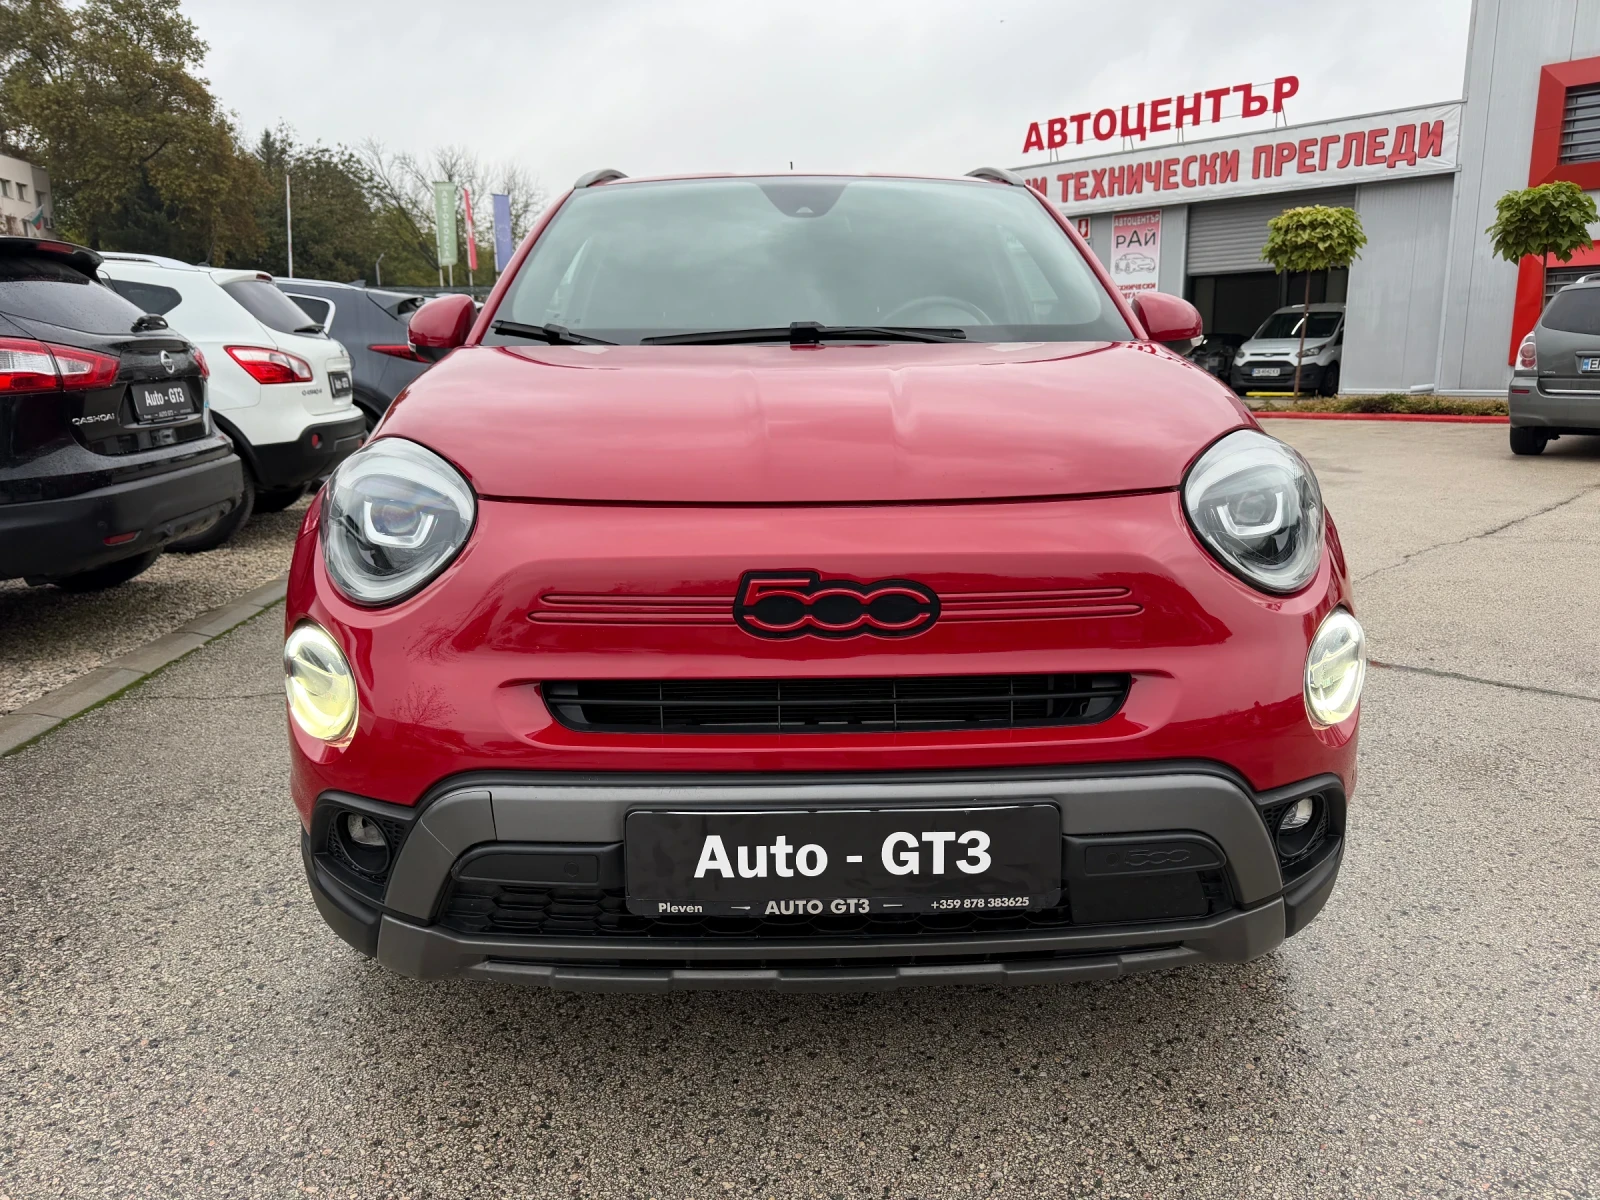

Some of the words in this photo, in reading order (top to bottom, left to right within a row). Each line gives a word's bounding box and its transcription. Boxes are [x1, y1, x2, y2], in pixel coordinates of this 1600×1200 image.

[1023, 75, 1300, 154] АВТОЦЕНТЪР
[1057, 149, 1240, 203] ТЕХНИЧЕСКИ
[1251, 120, 1445, 180] ПРЕГЛЕДИ
[1114, 214, 1160, 227] АВТОЦЕНТЪР
[1115, 229, 1157, 249] РАЙ
[144, 390, 164, 406] Auto
[168, 387, 185, 404] GT3
[741, 577, 933, 633] 500
[694, 834, 828, 878] Auto
[881, 830, 992, 875] GT3
[658, 902, 703, 913] Pleven
[764, 899, 824, 915] AUTO
[830, 898, 870, 914] GT3
[931, 899, 961, 909] +359
[963, 898, 985, 908] 878
[987, 896, 1030, 908] 383625
